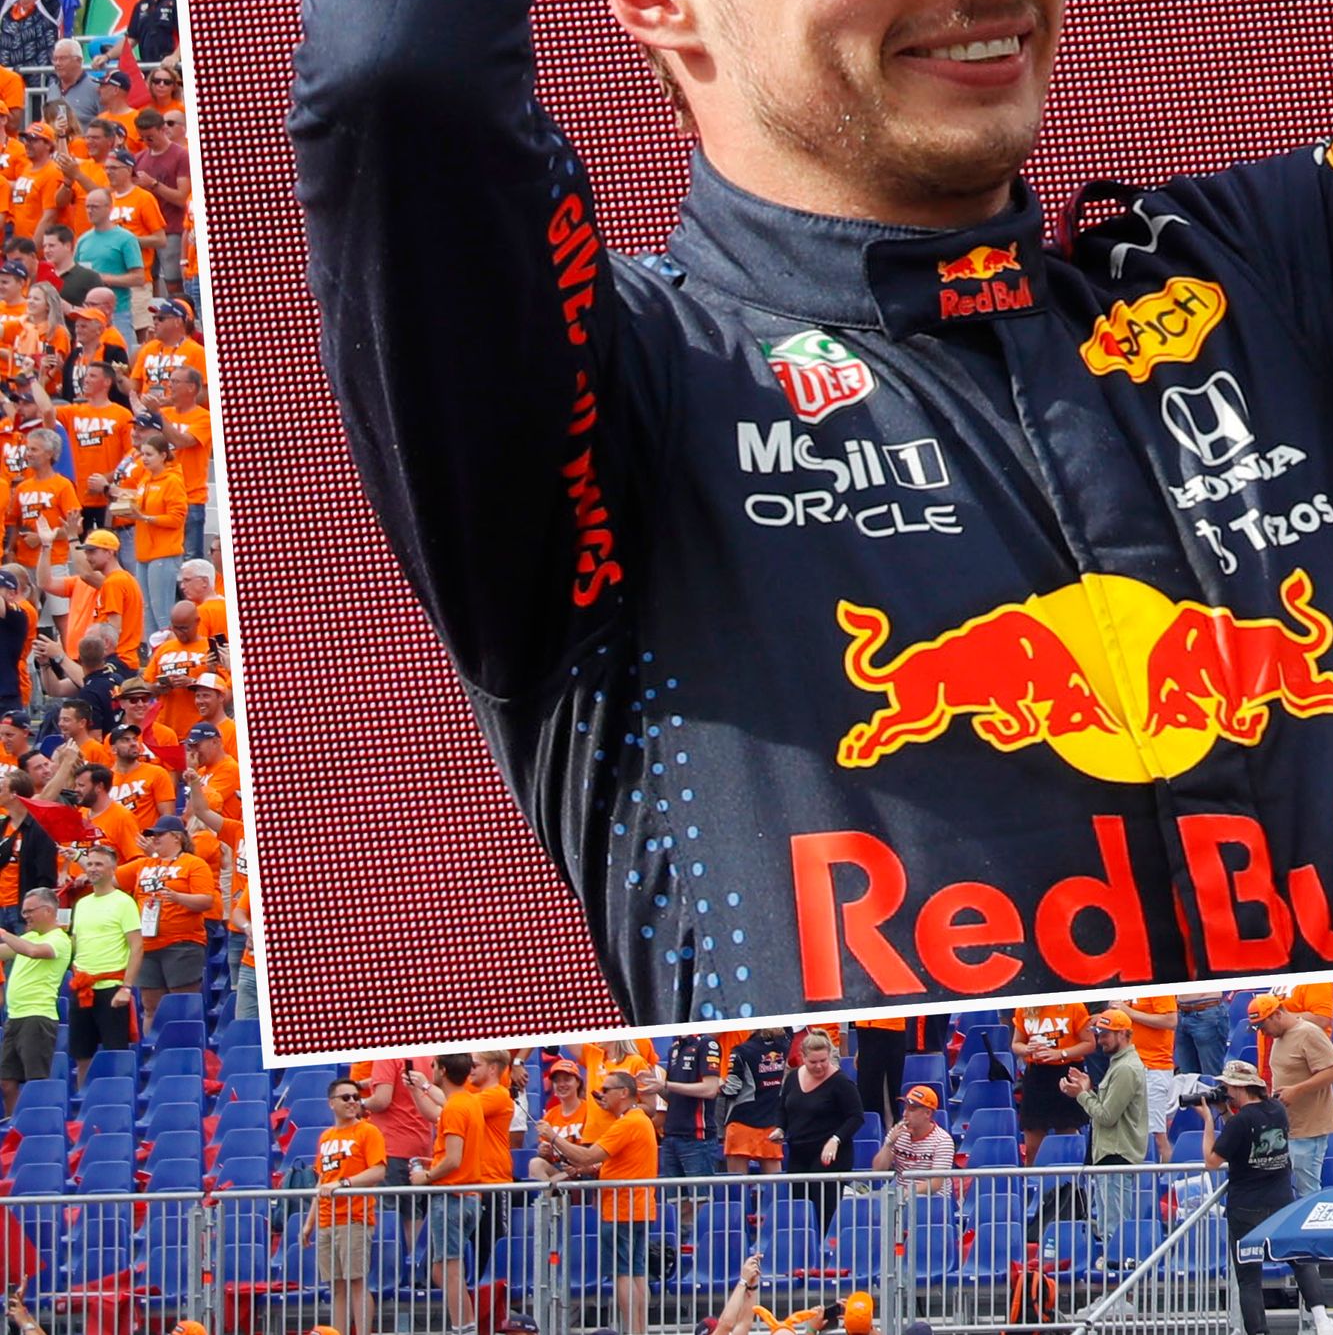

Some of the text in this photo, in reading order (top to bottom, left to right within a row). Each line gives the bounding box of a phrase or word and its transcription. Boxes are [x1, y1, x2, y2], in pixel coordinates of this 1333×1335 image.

[940, 277, 1034, 319] Red Bull
[74, 417, 117, 435] MAX
[160, 651, 206, 663] MAX
[790, 815, 1153, 1001] Red
[1023, 1016, 1070, 1035] MAX
